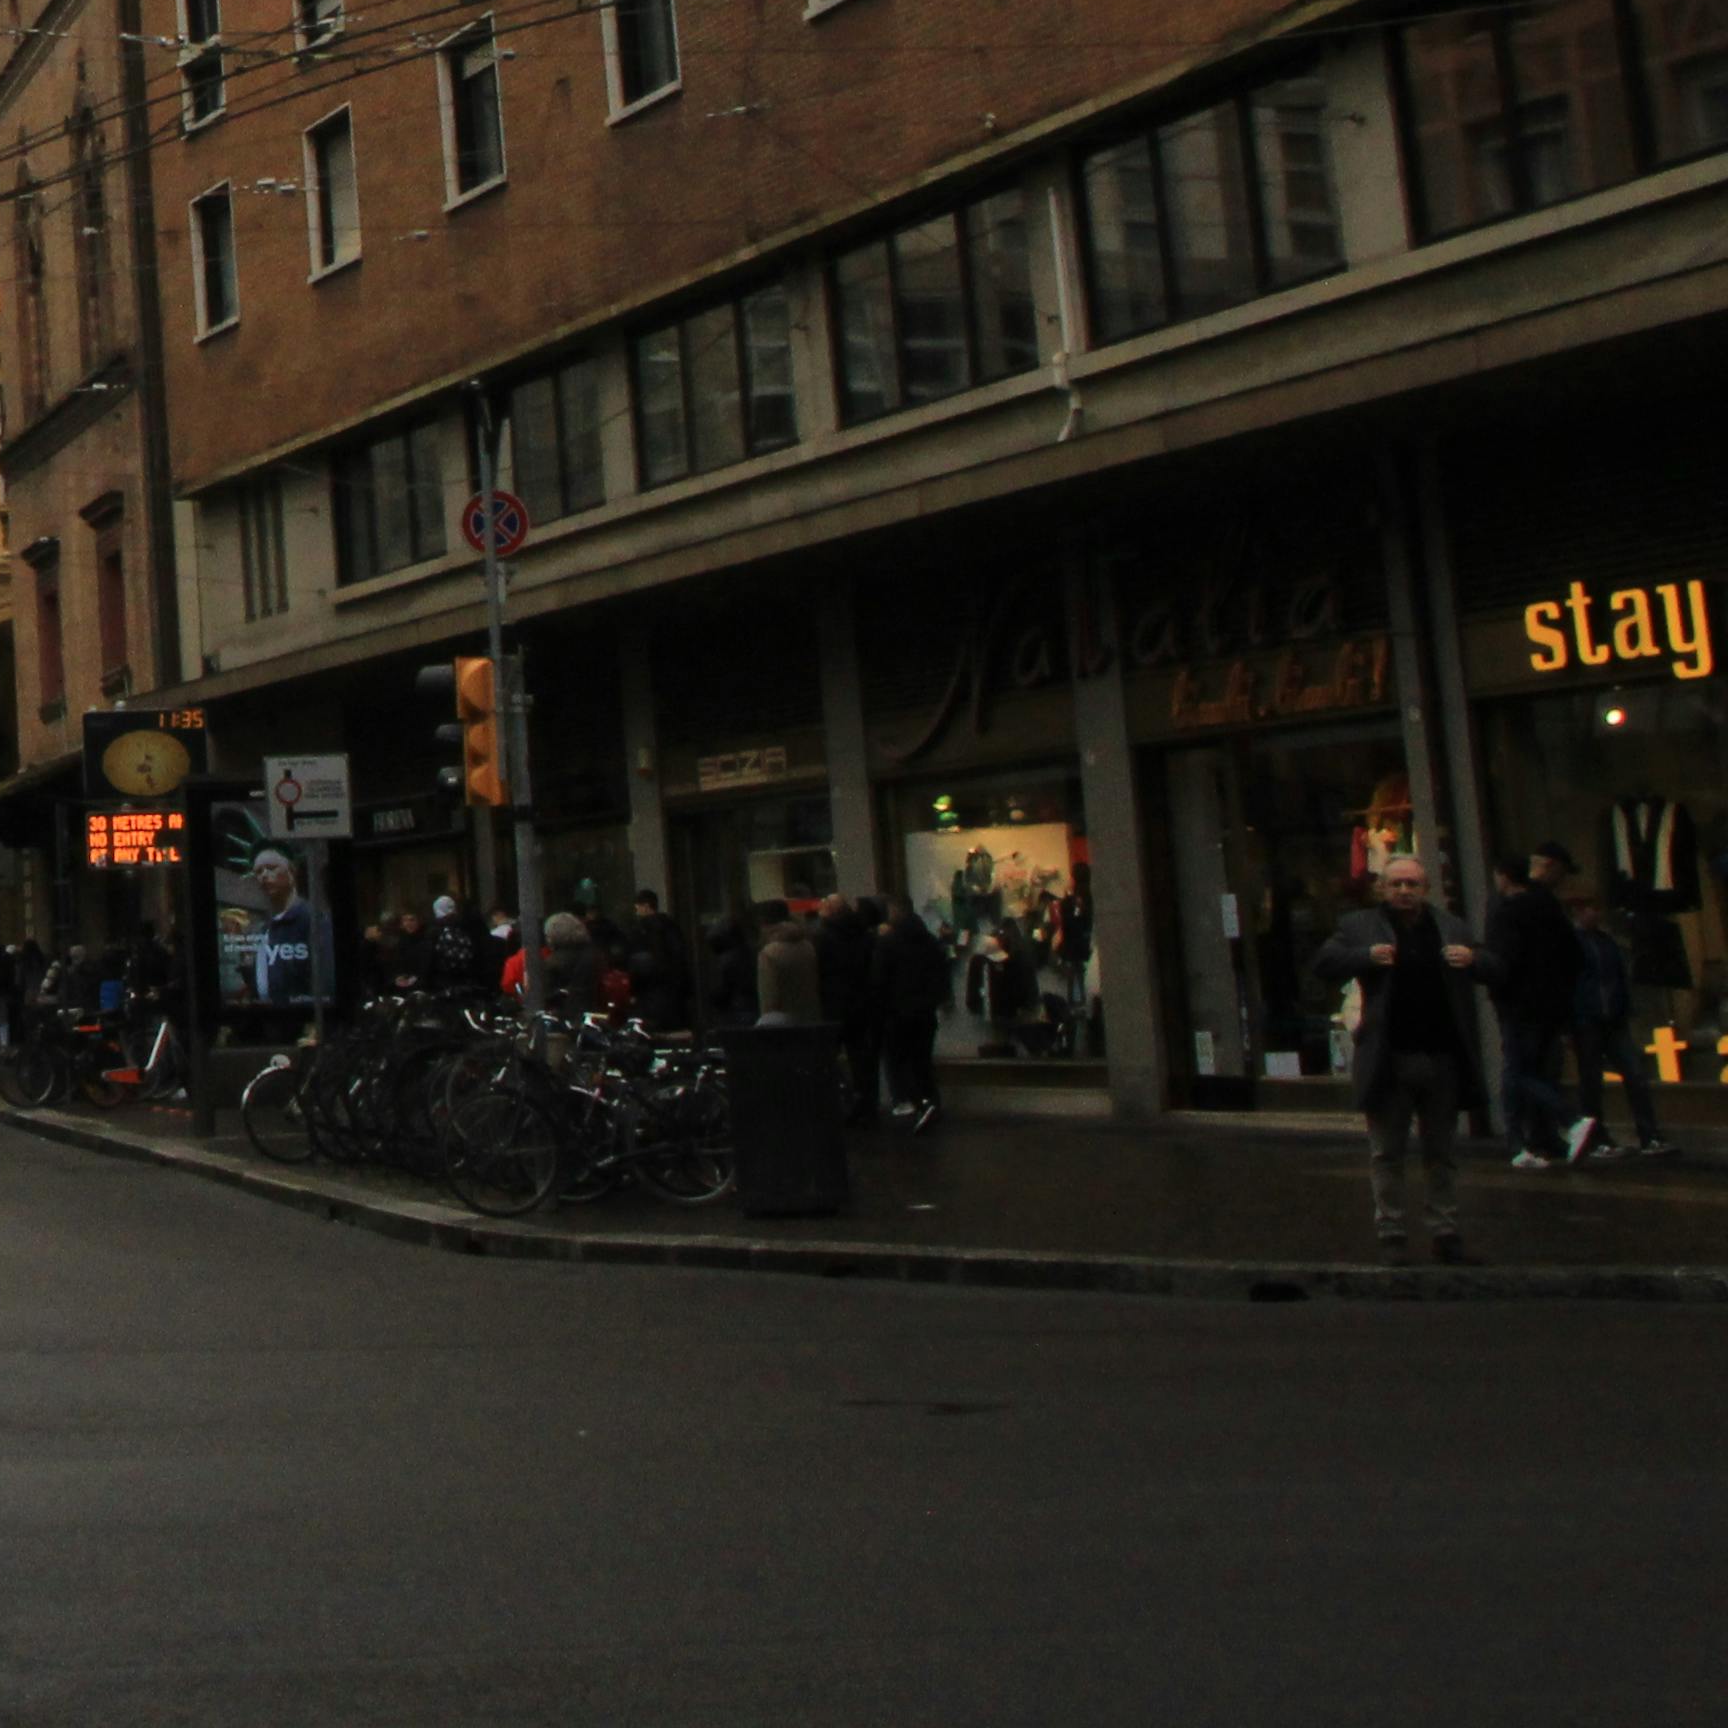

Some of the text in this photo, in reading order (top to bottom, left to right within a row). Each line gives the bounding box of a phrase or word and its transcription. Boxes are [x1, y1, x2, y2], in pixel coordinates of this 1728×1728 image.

[1525, 579, 1722, 679] stay
[88, 815, 107, 831] 30
[111, 814, 163, 830] METRES
[89, 830, 156, 847] NO ENTRY
[264, 942, 309, 966] yes
